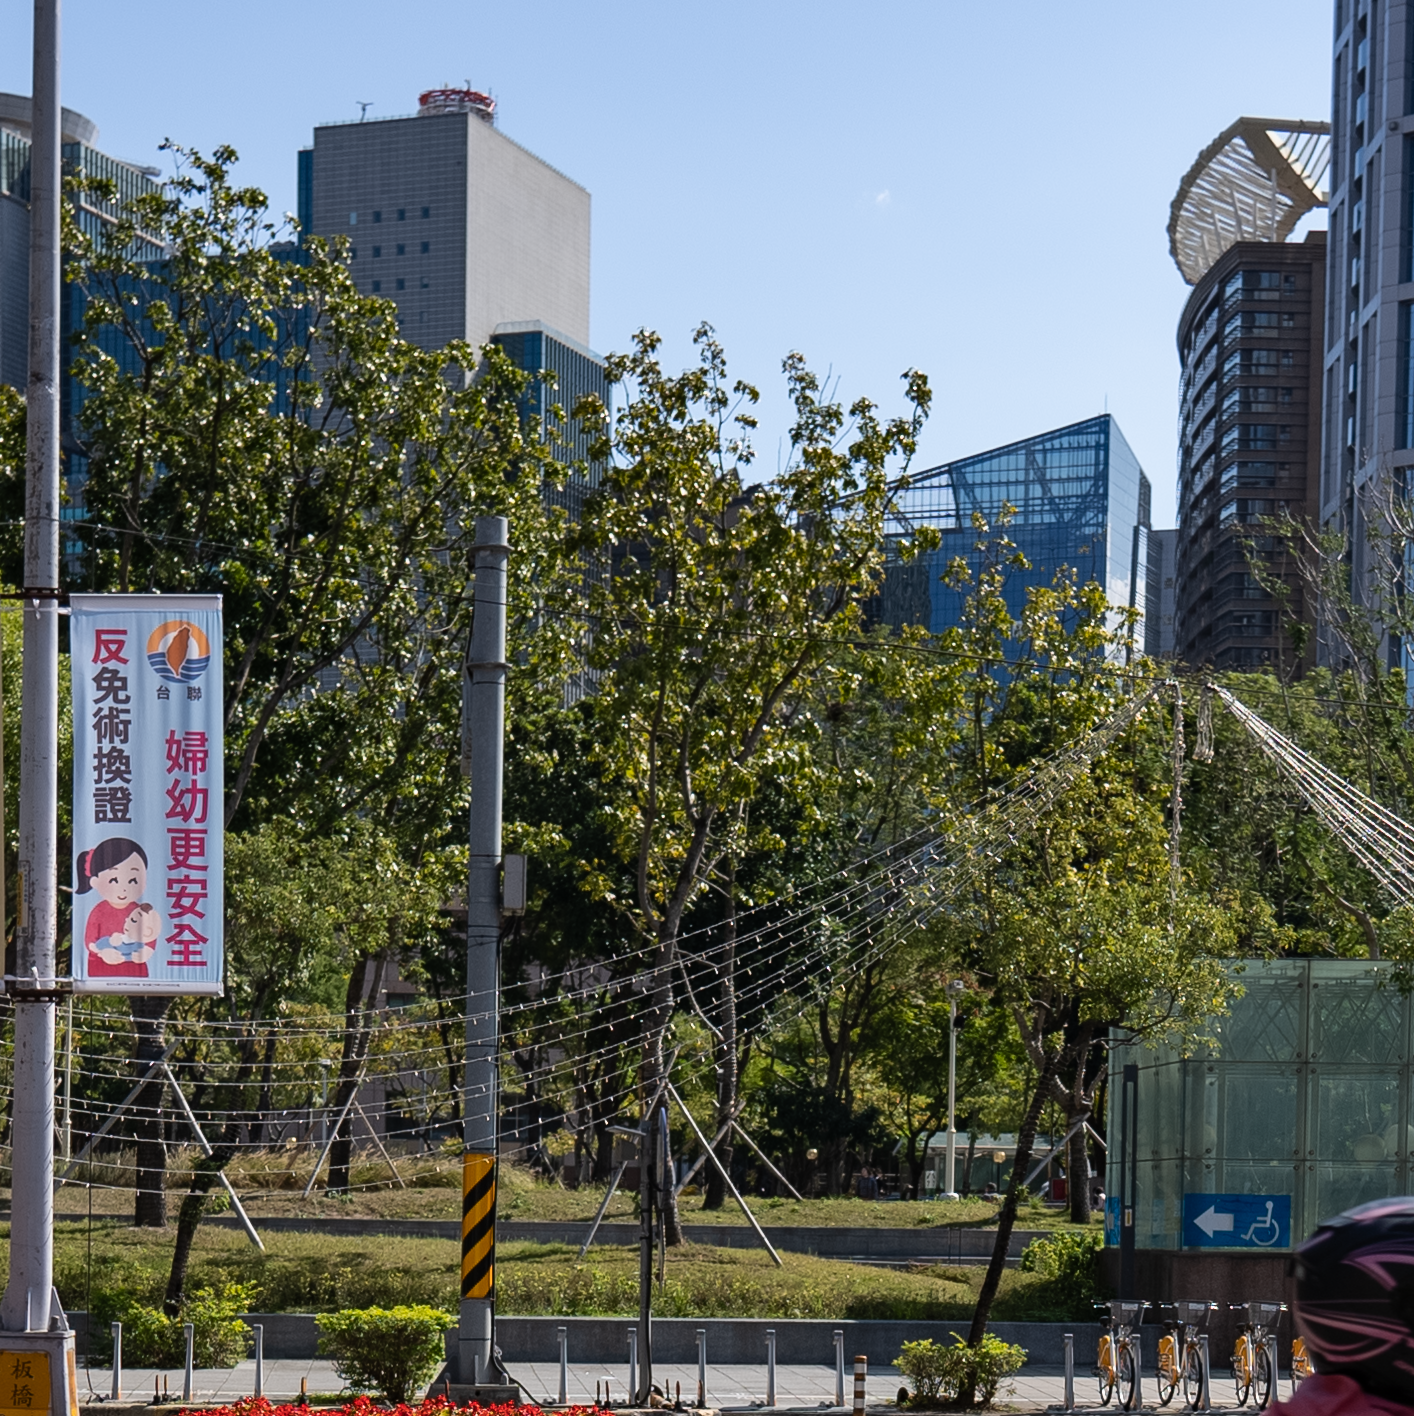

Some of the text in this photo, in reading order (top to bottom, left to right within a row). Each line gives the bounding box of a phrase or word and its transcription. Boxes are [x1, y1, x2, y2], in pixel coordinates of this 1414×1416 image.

[92, 628, 132, 824] 反免術換證
[156, 685, 202, 701] 台聯
[165, 729, 209, 967] 婦幼更安全
[11, 1358, 34, 1407] 板橋
